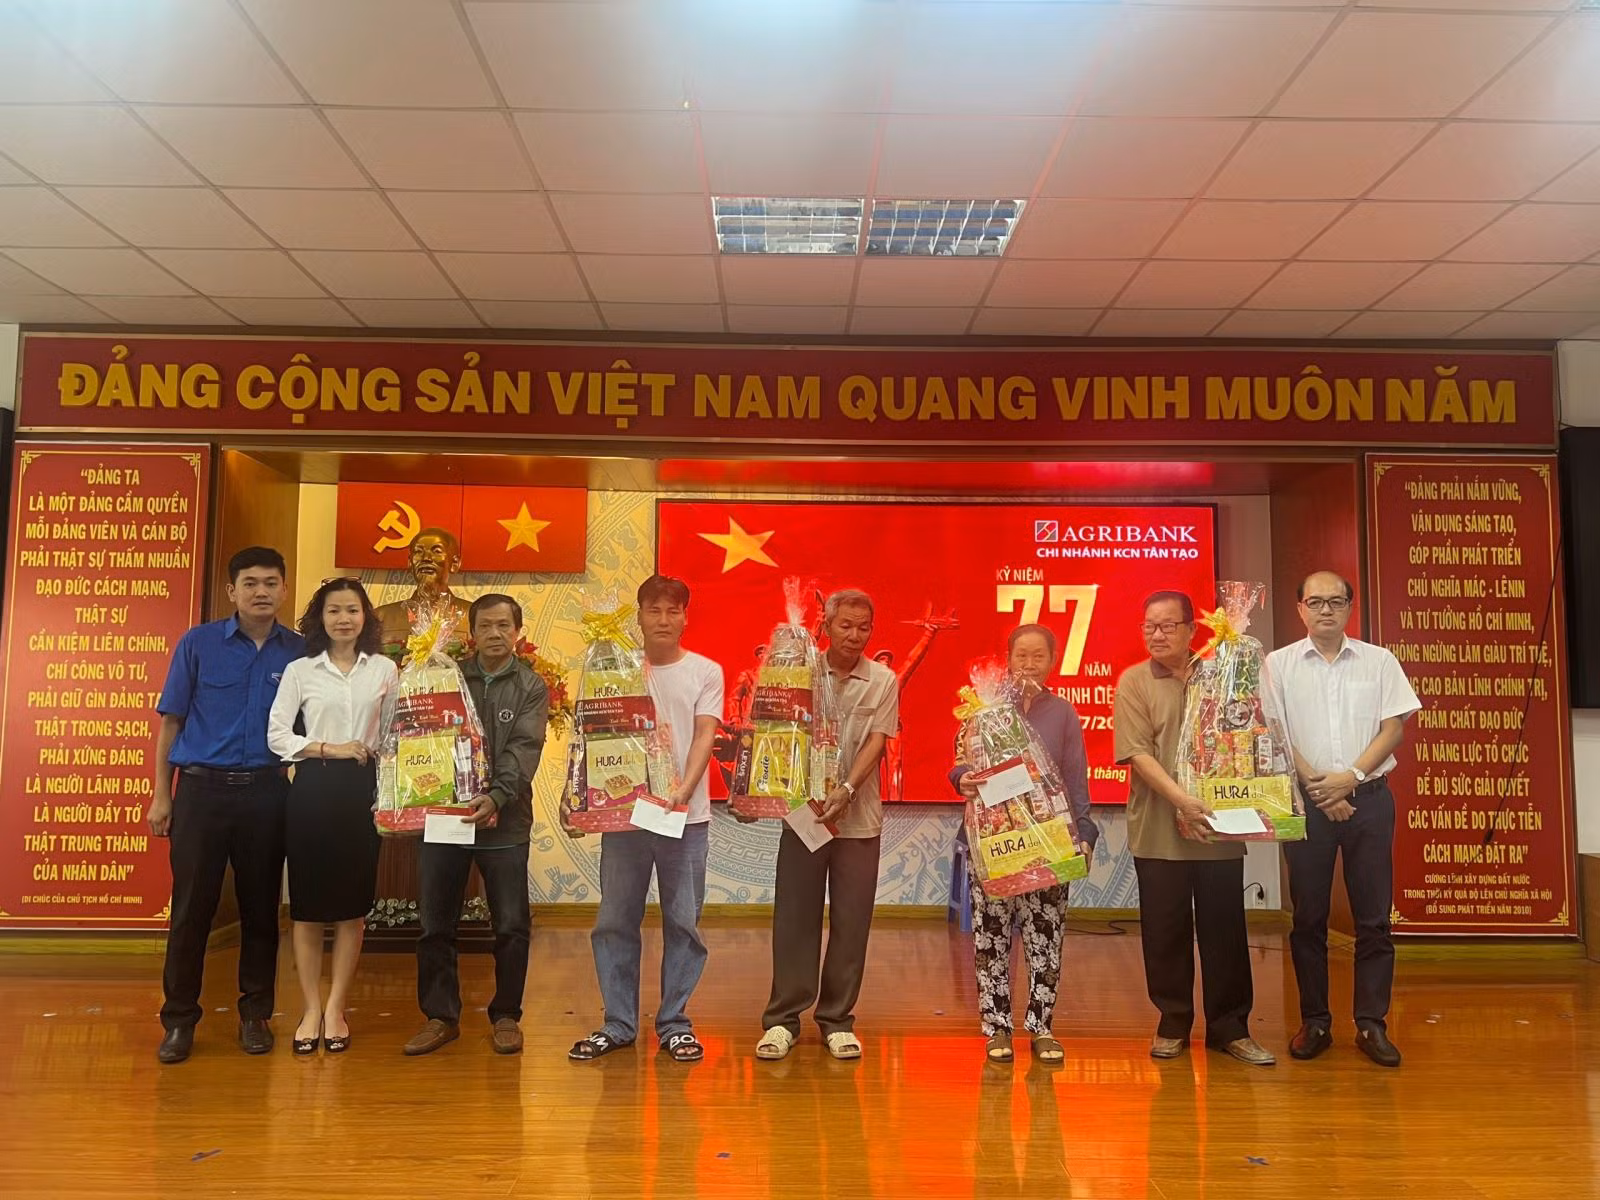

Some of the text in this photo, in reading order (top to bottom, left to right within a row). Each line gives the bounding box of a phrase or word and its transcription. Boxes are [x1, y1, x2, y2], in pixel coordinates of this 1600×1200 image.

[58, 344, 1516, 429] ĐẢNG CỘNG SẢN VIỆT NAM QUANG VINH MUÔN NĂM
[125, 470, 140, 484] TA
[1441, 476, 1463, 500] PHẢI
[1467, 475, 1488, 500] NẮM
[1492, 479, 1521, 504] VỮNG,
[29, 492, 43, 511] LÀ
[50, 492, 75, 514] MỘT
[79, 491, 112, 512] ĐẢNG
[147, 491, 187, 515] QUYỀN
[26, 516, 187, 543] MỖI ĐẢNG VIÊN VÀ CÁN BỘ
[1062, 526, 1197, 542] AGRIBANK
[1412, 510, 1516, 536] VẬN DỤNG SÁNG TẠO,
[20, 545, 189, 570] PHẢI THẬT SỰ THẤM NHUẦN
[1037, 546, 1198, 560] CHI NHÁNH KCN TÂN TẠO
[1410, 538, 1521, 565] GÓP PHẦN PHÁT TRIỂN
[1014, 567, 1044, 584] NIỆM
[1408, 572, 1525, 598] CHỦ NGHĨA MÁC LÊNIN
[36, 576, 169, 599] ĐẠO ĐỨC CÁCH MẠNG,
[75, 604, 128, 626] THẬT SỰ
[1401, 604, 1534, 633] VÀ TƯ TƯỞNG HỒ CHÍ MINH,
[58, 632, 89, 654] KIỆM
[94, 632, 124, 651] LIÊM
[128, 632, 168, 655] CHÍNH,
[1423, 640, 1456, 662] NGỪNG
[1460, 641, 1480, 662] LÀM
[1484, 641, 1506, 663] GIÀU
[1509, 642, 1526, 663] TRÍ
[47, 660, 147, 683] CHÍ CÔNG VÔ TƯ,
[1085, 662, 1111, 676] NĂM
[1422, 678, 1441, 695] CAO
[1445, 671, 1465, 696] BẢN
[1469, 674, 1491, 696] LĨNH
[1495, 674, 1524, 696] CHÍNH
[28, 686, 143, 708] PHẢI GIỮ GÌN ĐẢNG
[35, 717, 152, 739] THẬT TRONG SẠCH,
[1418, 701, 1523, 732] PHẨM CHẤT ĐẠO ĐỨC
[40, 743, 143, 765] PHẢI XỨNG ĐÁNG
[406, 755, 431, 766] HURA
[596, 756, 622, 767] HURA
[1416, 739, 1429, 761] VÀ
[1433, 740, 1459, 762] NĂNG
[1463, 741, 1482, 766] LỰC
[1485, 735, 1498, 762] TỔ
[26, 773, 153, 797] LÀ NGƯỜI LÃNH ĐẠO,
[1094, 767, 1126, 782] tháng
[1417, 767, 1430, 795] ĐỂ
[1435, 770, 1448, 795] ĐỦ
[1452, 772, 1471, 796] SỨC
[1475, 771, 1494, 796] GIẢI
[1215, 785, 1248, 799] HURA
[34, 802, 49, 822] LÀ
[54, 803, 91, 823] NGƯỜI
[125, 803, 142, 823] TỚ
[1408, 805, 1428, 828] CÁC
[1431, 803, 1451, 829] VẤN
[1455, 803, 1468, 829] ĐỀ
[1472, 812, 1485, 829] DO
[1518, 803, 1541, 830] TIỄN
[24, 831, 147, 854] THẬT TRUNG THÀNH
[991, 836, 1026, 857] HURA
[1424, 839, 1450, 863] CÁCH
[1454, 845, 1483, 867] MẠNG
[1486, 842, 1505, 868] ĐẶT
[33, 858, 58, 880] CỦA
[62, 860, 96, 880] NHÂN
